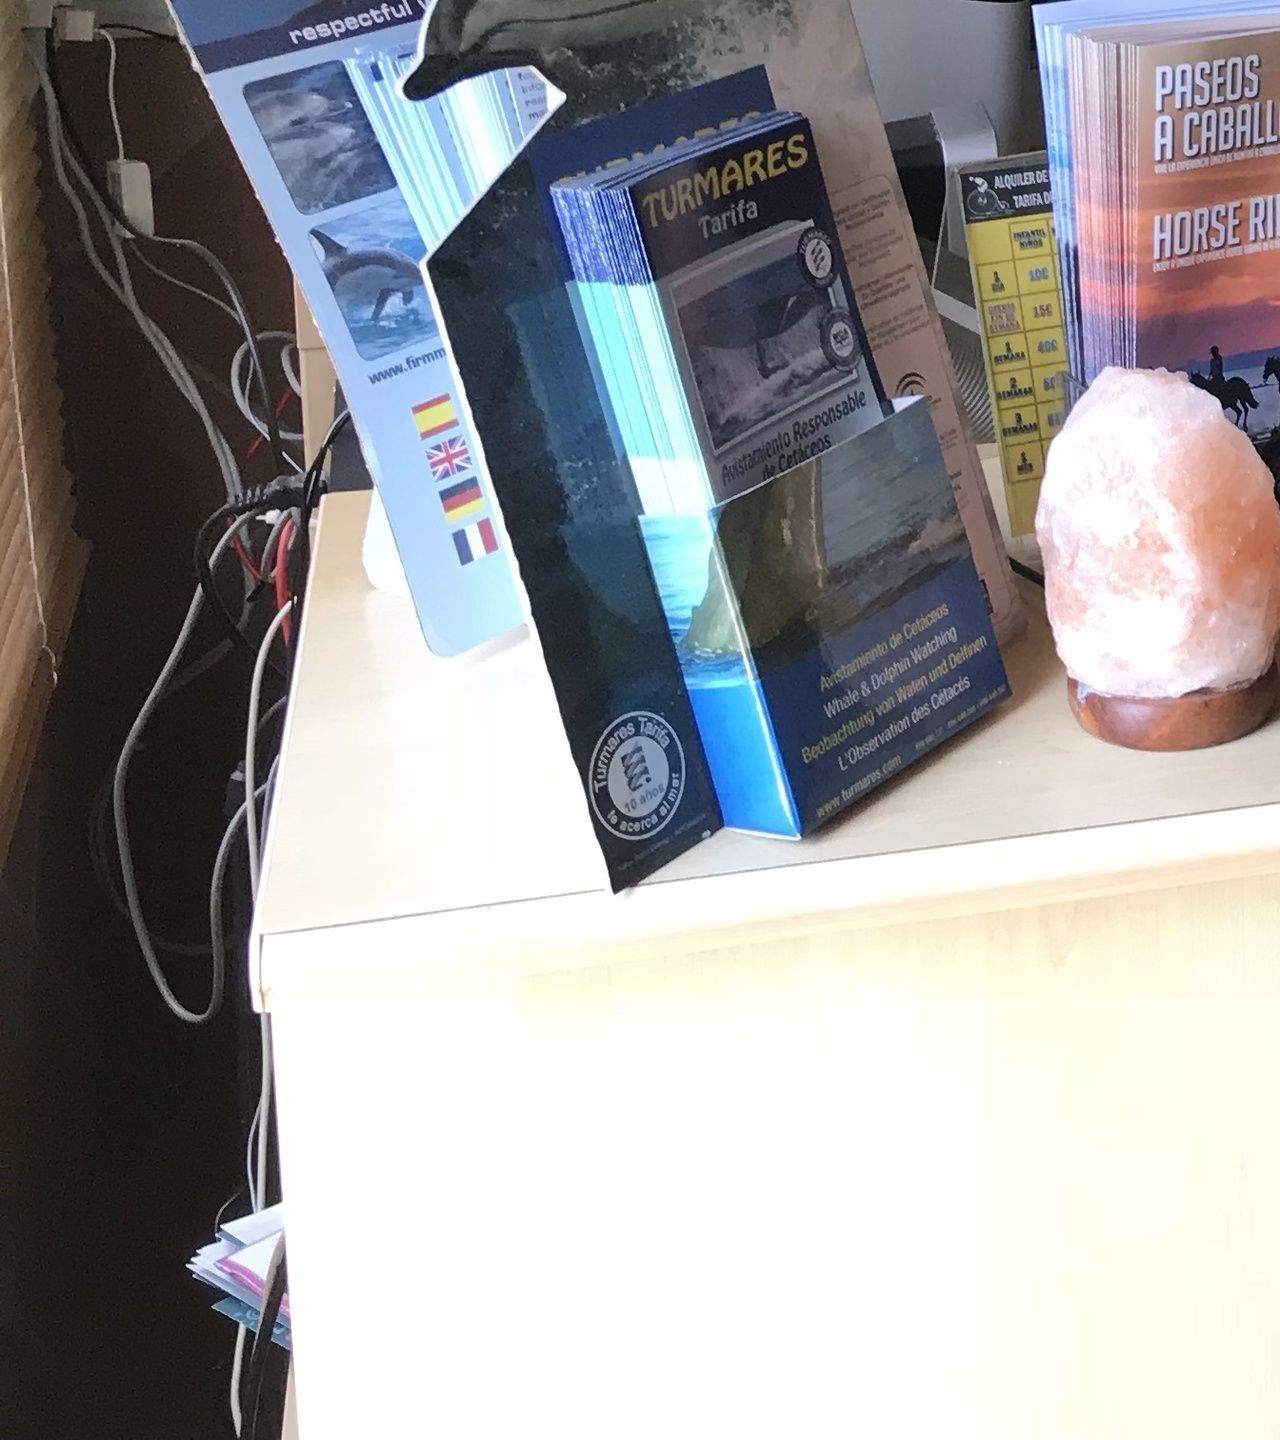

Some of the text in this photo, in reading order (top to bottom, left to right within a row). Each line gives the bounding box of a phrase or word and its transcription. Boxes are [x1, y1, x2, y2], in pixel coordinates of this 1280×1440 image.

[1155, 54, 1260, 111] PASEOS
[1155, 116, 1174, 161] A
[642, 134, 808, 228] TURMARES
[994, 170, 1048, 190] ALQUILER DE
[1013, 192, 1044, 208] TARIFA
[698, 200, 759, 239] Tarifa
[1153, 201, 1243, 260] HORSE
[721, 391, 866, 486] Avistamiento Responsable
[820, 643, 888, 693] Avistamiento
[889, 634, 903, 649] de
[823, 627, 957, 719] Whale & Dolphin Watching
[802, 636, 987, 763] Beobachtung von Walen und Delfinen
[838, 713, 911, 772] L'Observation
[911, 703, 931, 723] des
[930, 674, 970, 710] Cétacés
[594, 717, 670, 793] Turmares Tarifa
[620, 802, 670, 832] acerca al
[625, 784, 665, 812] 10 años
